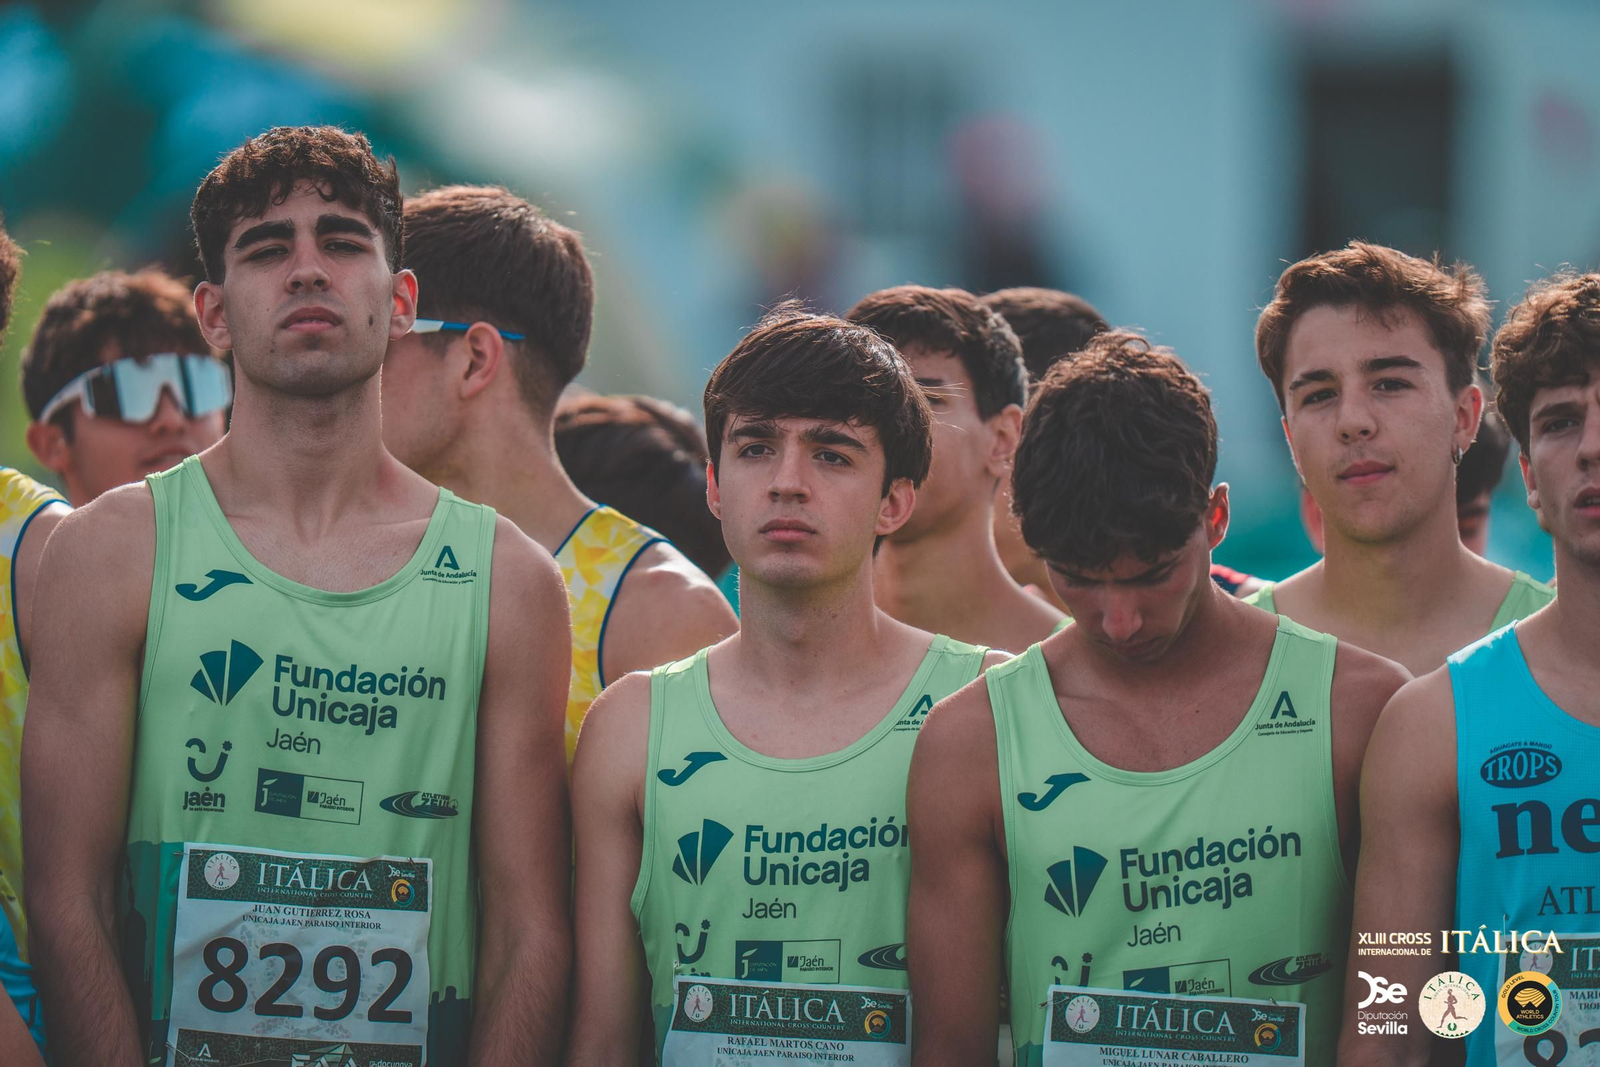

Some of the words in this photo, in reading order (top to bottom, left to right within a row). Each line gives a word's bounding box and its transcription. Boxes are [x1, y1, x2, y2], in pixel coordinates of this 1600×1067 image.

[446, 570, 477, 578] Andalucía
[274, 654, 446, 701] Fundación
[272, 686, 398, 736] Unicaja
[1284, 718, 1316, 728] Andalucía
[266, 728, 321, 754] Jaén
[1529, 741, 1552, 749] MANGO
[1485, 751, 1558, 780] TROPS
[320, 792, 346, 806] Jaén
[1120, 825, 1301, 879] Fundación
[257, 861, 373, 891] ITÁLICA
[744, 852, 869, 892] Unicaja
[258, 887, 317, 897] INTERNATIONAL
[1122, 867, 1253, 912] Unicaja
[742, 897, 796, 918] Jaén
[1537, 886, 1600, 916] ATL
[253, 905, 281, 914] JUAN
[284, 907, 341, 918] GUTIERREZ
[344, 910, 371, 919] ROSA
[243, 915, 279, 924] UNICAJA
[305, 920, 339, 928] PARAISO
[342, 922, 381, 930] INTERIOR
[1127, 922, 1181, 947] Jaén
[800, 955, 824, 967] Jaén
[1570, 946, 1600, 971] IT
[198, 936, 413, 1023] 8292
[1188, 977, 1215, 991] Jaén
[1569, 991, 1600, 1000] MARI
[729, 991, 845, 1024] ITÁLICA
[730, 1019, 785, 1028] INTERNATIONAL
[1115, 1001, 1235, 1034] ITÁLICA
[727, 1036, 768, 1046] RAFAEL
[769, 1039, 813, 1049] MARTOS
[816, 1041, 845, 1051] CANO
[1116, 1030, 1172, 1040] INTERNATIONAL
[1201, 1034, 1237, 1042] COUNTRY
[717, 1047, 752, 1056] UNICAJA
[753, 1049, 775, 1057] JAEN
[777, 1050, 812, 1059] PARAISO
[814, 1052, 854, 1062] INTERIOR
[1100, 1047, 1139, 1058] MIGUEL
[1142, 1050, 1179, 1060] LUNAR
[1182, 1052, 1249, 1063] CABALLERO
[1103, 1058, 1136, 1067] UNICAJA
